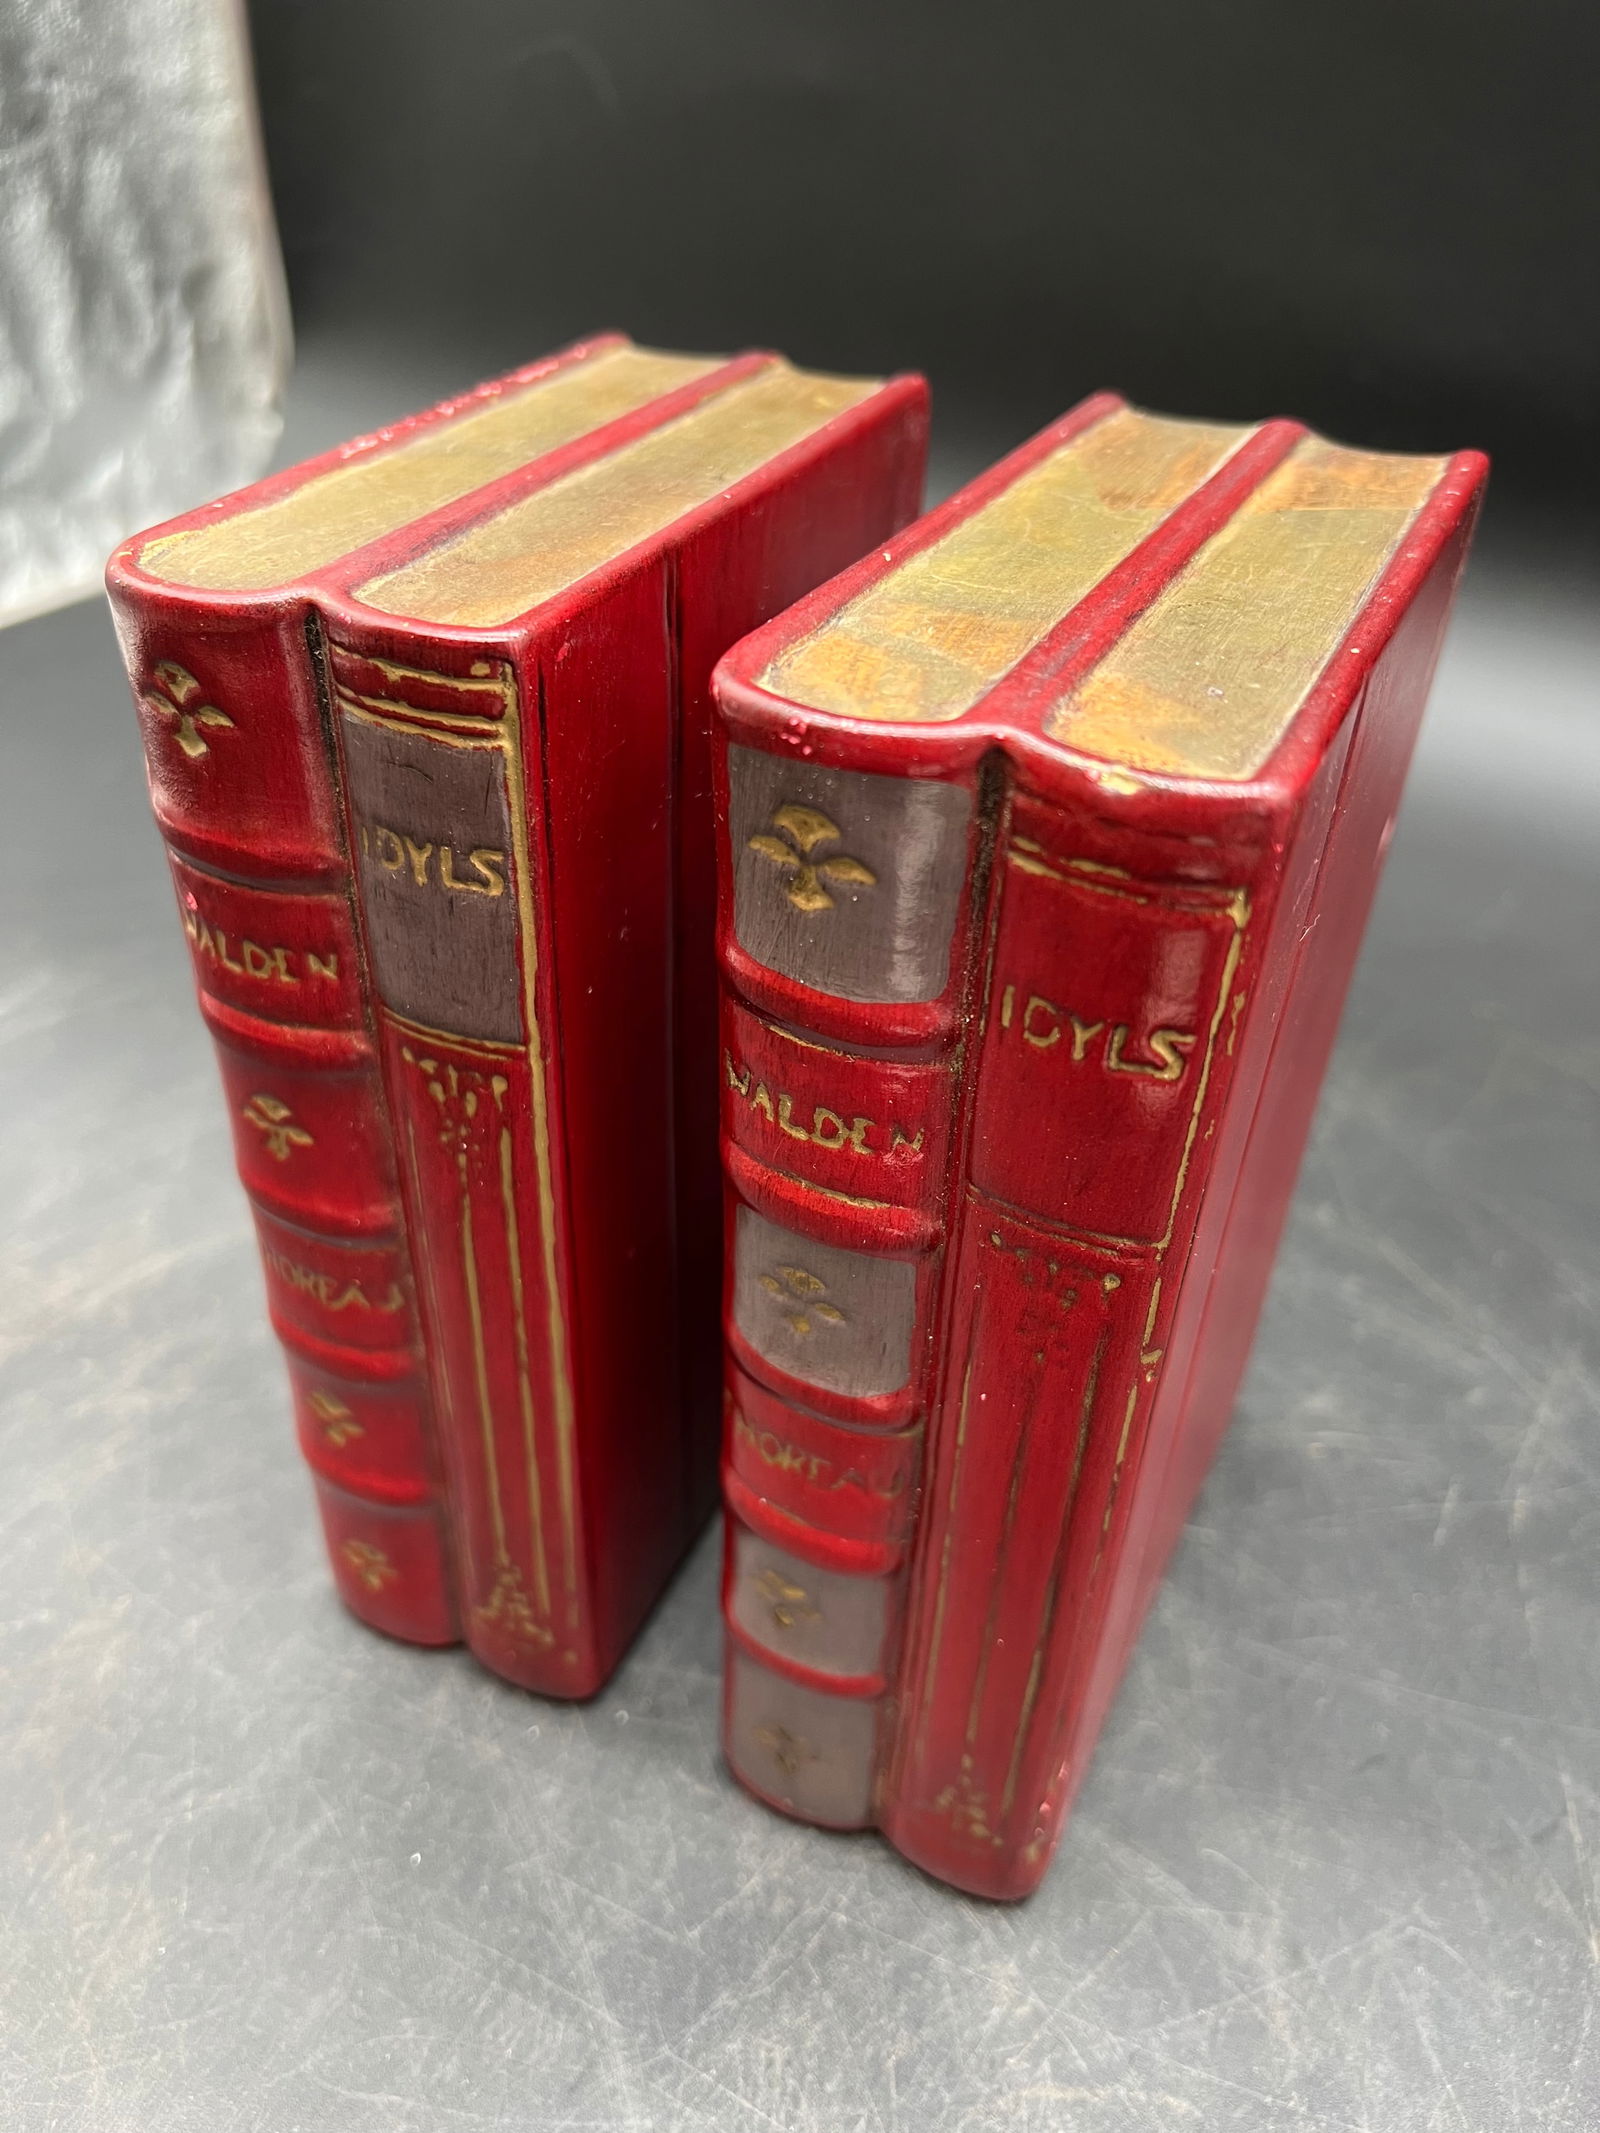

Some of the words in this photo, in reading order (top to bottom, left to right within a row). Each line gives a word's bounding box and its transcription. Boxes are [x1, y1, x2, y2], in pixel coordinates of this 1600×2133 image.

[362, 826, 504, 897] IDYLS
[1001, 984, 1197, 1081] IDYLS
[724, 1047, 924, 1157] WALDEN
